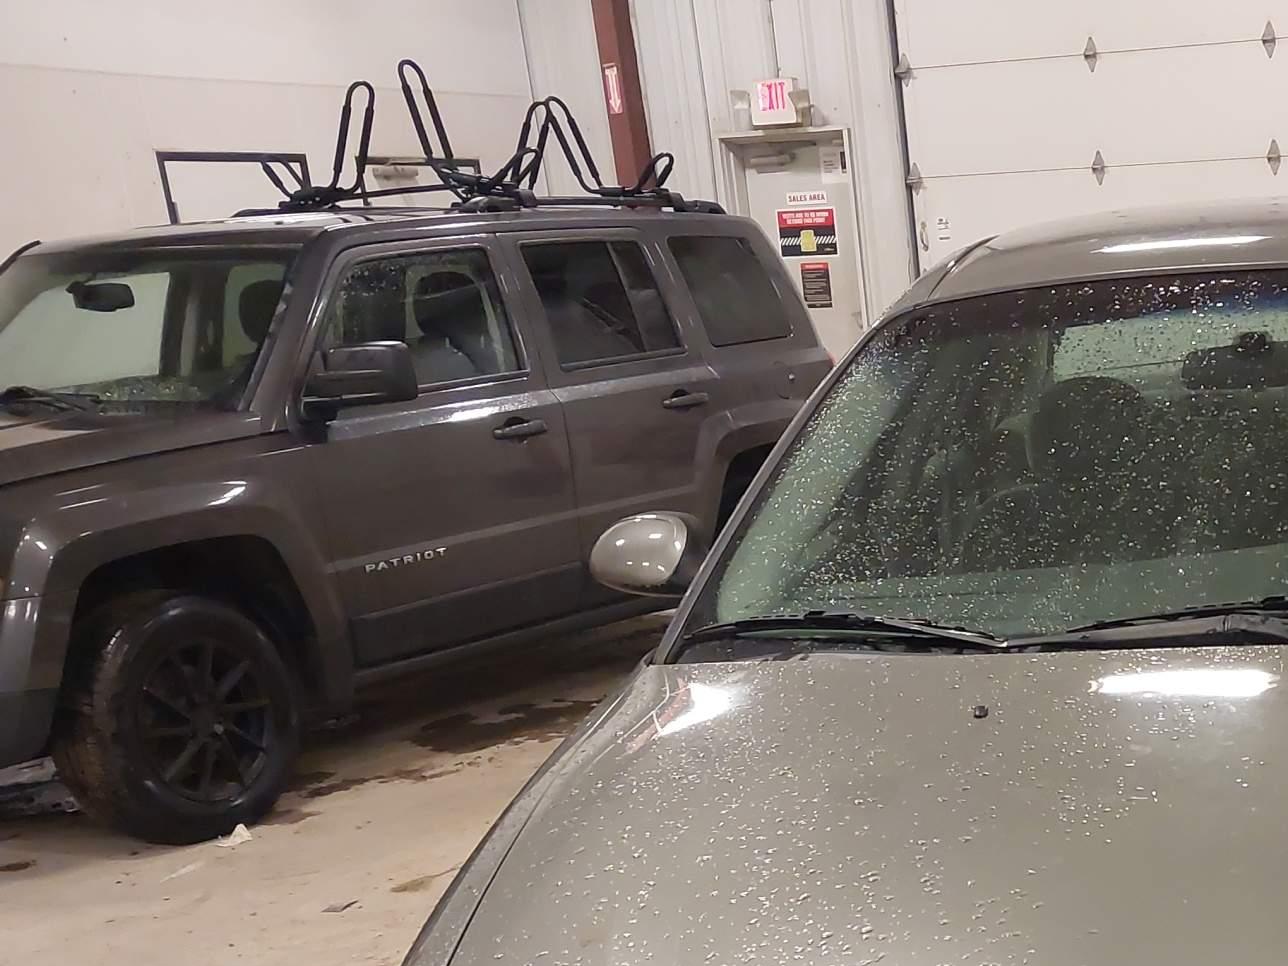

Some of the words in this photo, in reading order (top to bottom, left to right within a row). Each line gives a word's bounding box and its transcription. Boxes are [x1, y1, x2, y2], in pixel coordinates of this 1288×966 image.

[760, 82, 785, 111] EXIT
[788, 194, 807, 202] SALES
[809, 193, 826, 201] AREA
[365, 547, 447, 573] PATRIOT
